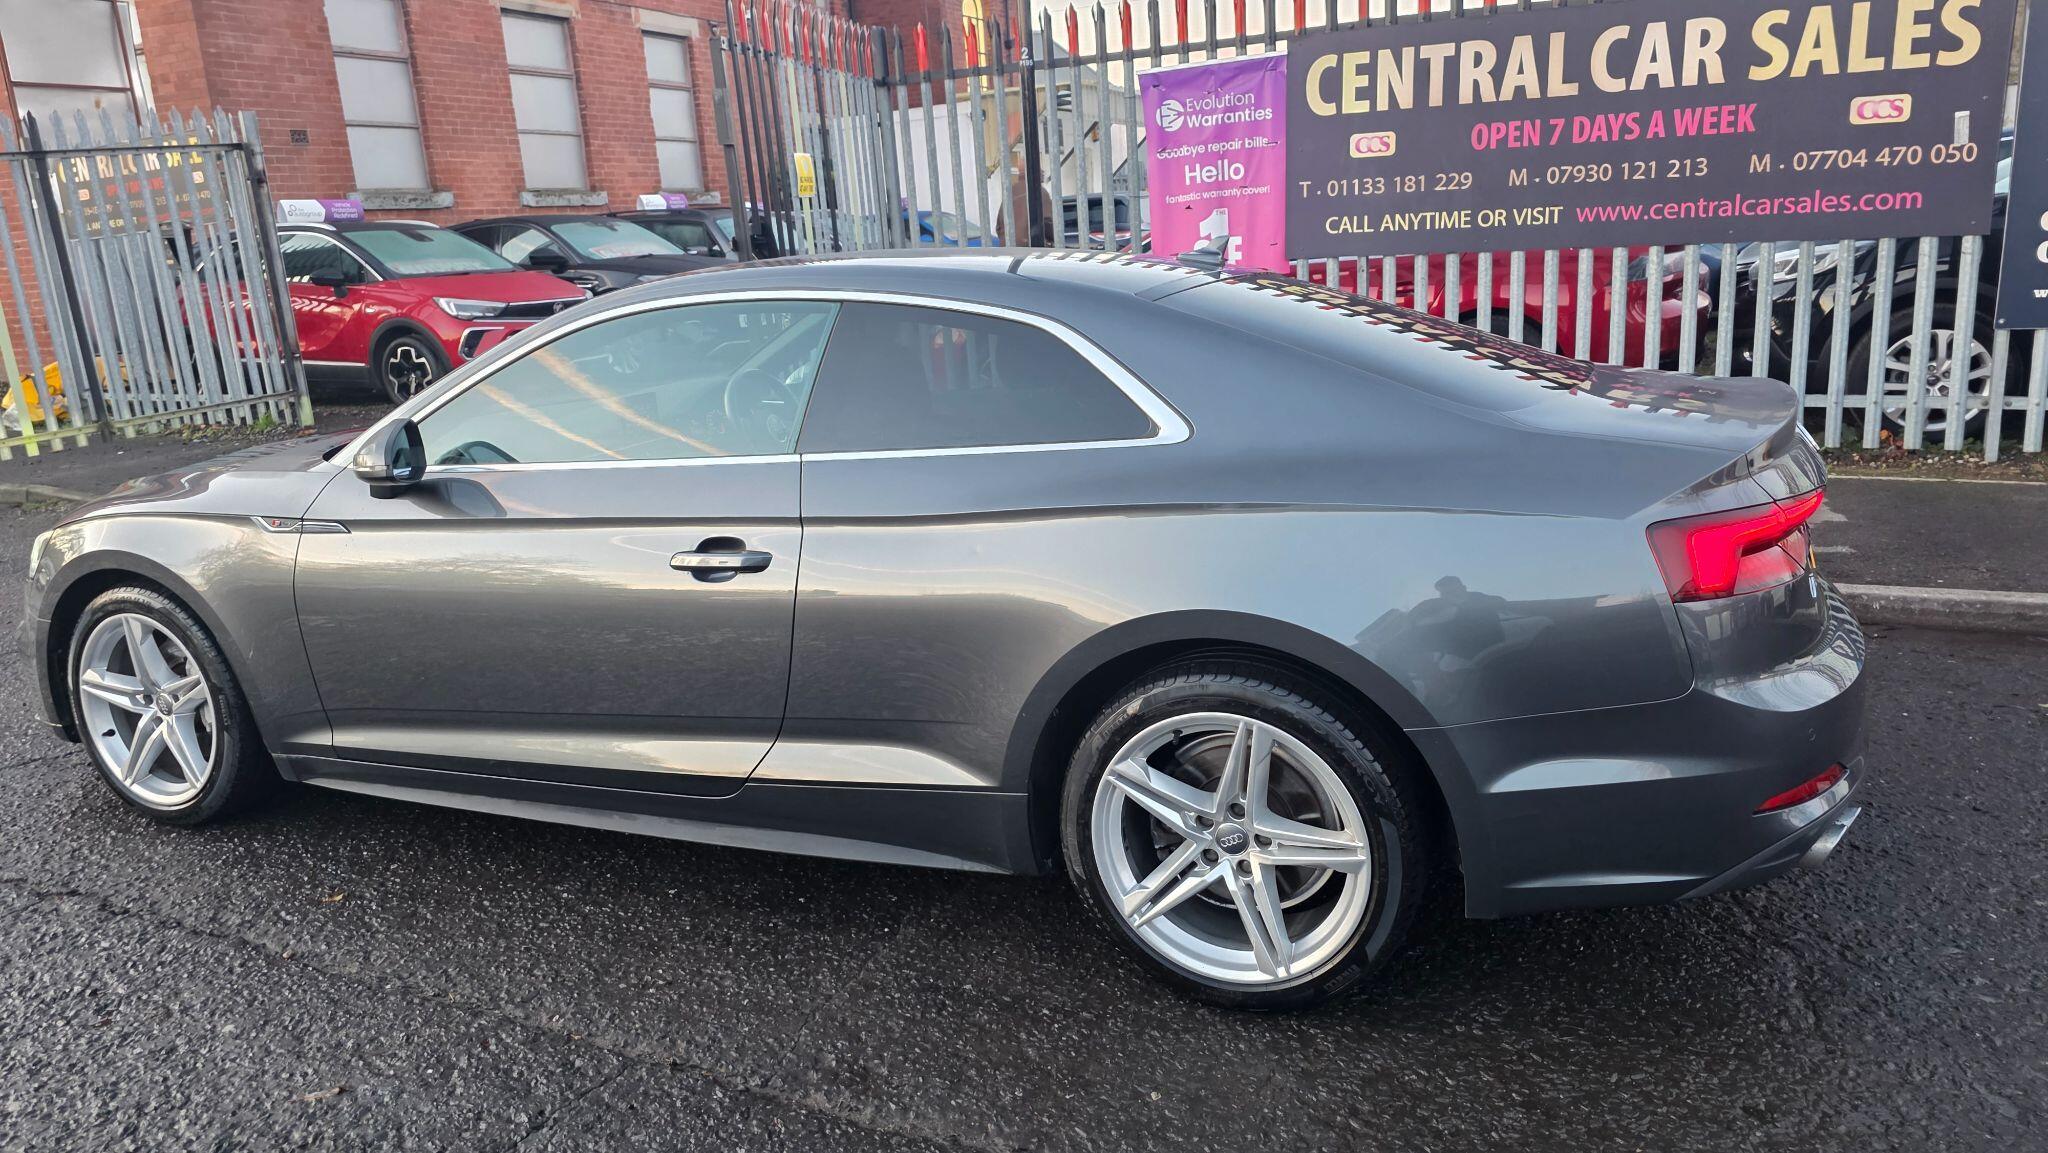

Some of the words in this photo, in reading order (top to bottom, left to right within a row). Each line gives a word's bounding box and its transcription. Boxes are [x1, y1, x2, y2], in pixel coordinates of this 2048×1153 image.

[1021, 46, 1029, 59] 2
[1306, 31, 1579, 116] CENTRAL
[1590, 17, 1727, 93] CAR
[1748, 0, 1982, 81] SALES
[1186, 92, 1255, 112] Evolution
[1856, 98, 1905, 120] CCS
[1187, 107, 1273, 128] Warranties
[1471, 119, 1541, 150] OPEN
[1549, 118, 1565, 146] 7
[1572, 112, 1641, 144] DAYS
[1646, 110, 1666, 139] A
[1673, 103, 1757, 137] WEEK
[1157, 143, 1205, 160] Goodbye
[1207, 139, 1242, 155] repair
[1355, 136, 1391, 154] CCS
[1750, 153, 1771, 173] M
[1793, 149, 1867, 171] 07704
[1875, 145, 1922, 167] 470
[1931, 143, 1978, 164] 050
[1184, 159, 1245, 186] Hello
[1509, 168, 1528, 186] M
[1547, 163, 1612, 185] 07930
[1621, 160, 1657, 180] 121
[1667, 157, 1708, 178] 213
[1165, 192, 1201, 204] fantastic
[1202, 187, 1242, 200] warranty
[1243, 185, 1271, 195] cover!
[1299, 181, 1311, 198] T
[1327, 178, 1385, 197] 01133
[1394, 175, 1425, 193] 181
[1434, 172, 1473, 191] 229
[1325, 215, 1374, 234] CALL
[1380, 210, 1472, 232] ANYTIME
[1477, 209, 1507, 227] OR
[1513, 206, 1564, 226] VISIT
[1576, 190, 1922, 222] www.centralcarsales.com
